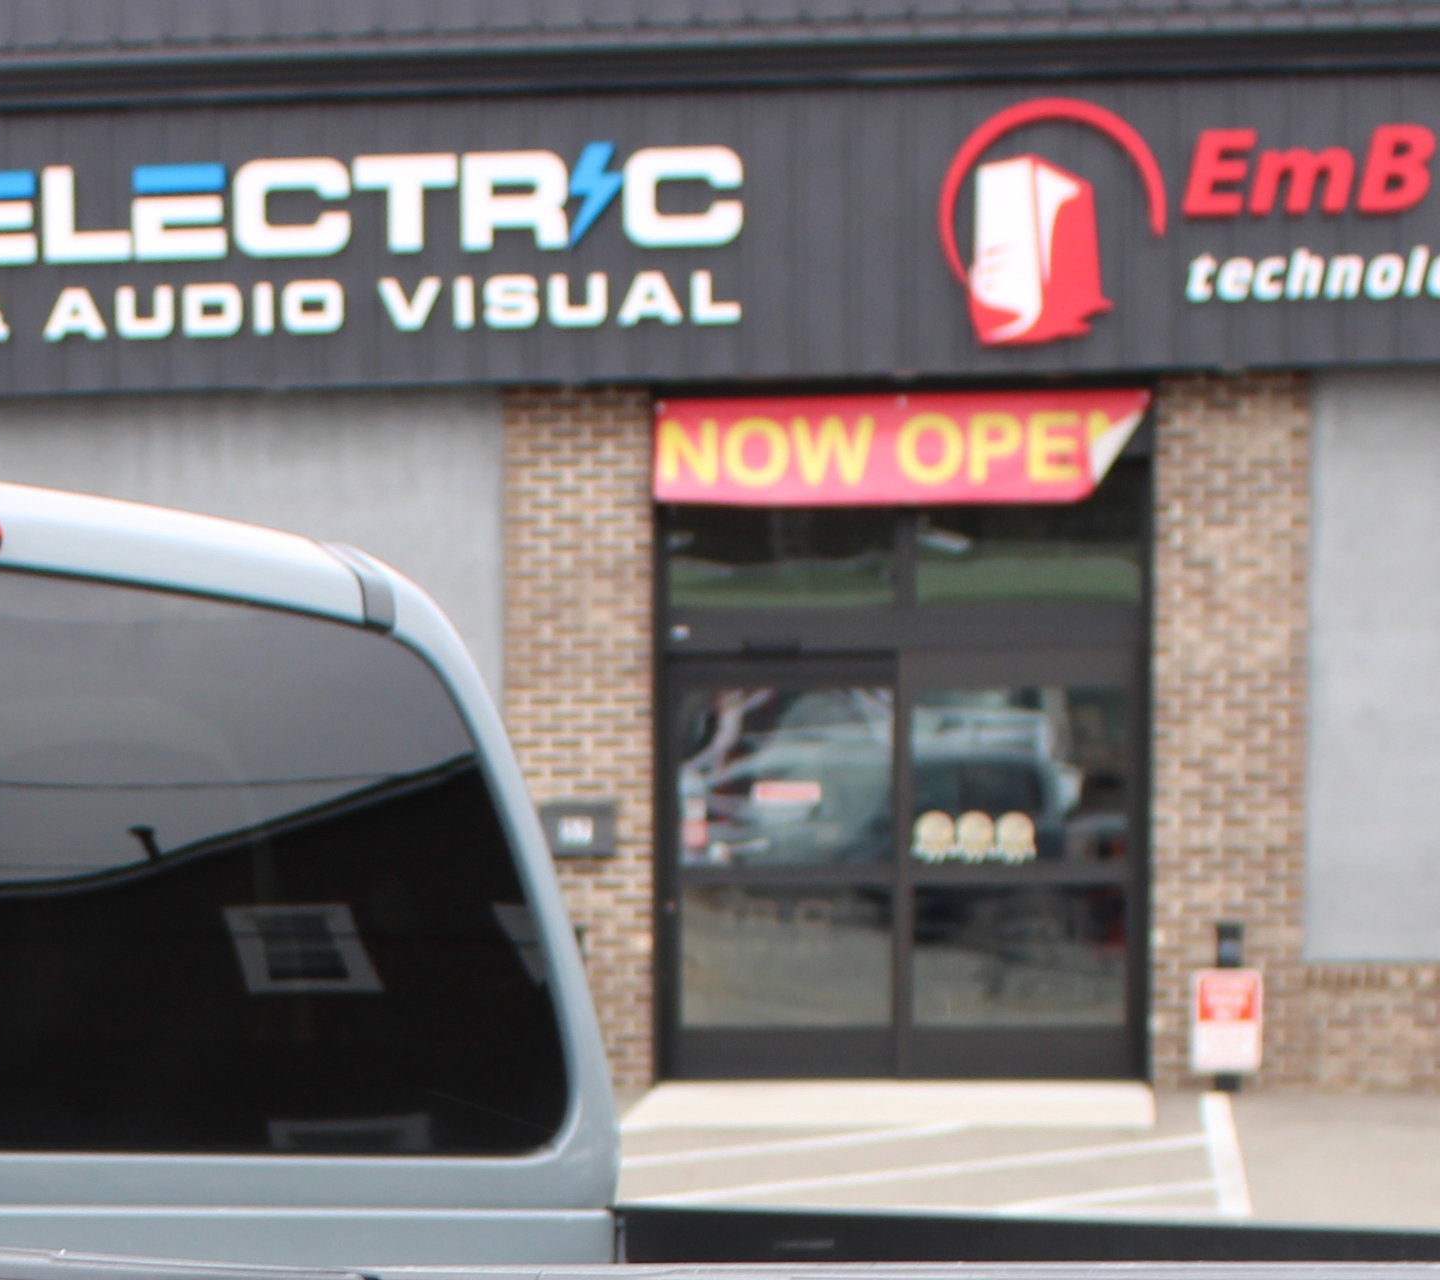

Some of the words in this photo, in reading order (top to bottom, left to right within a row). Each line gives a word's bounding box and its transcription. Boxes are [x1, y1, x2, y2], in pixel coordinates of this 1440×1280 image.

[1181, 123, 1437, 218] EmB
[42, 277, 346, 342] AUDIO
[377, 270, 744, 332] VISUAL
[658, 413, 877, 487] NOW
